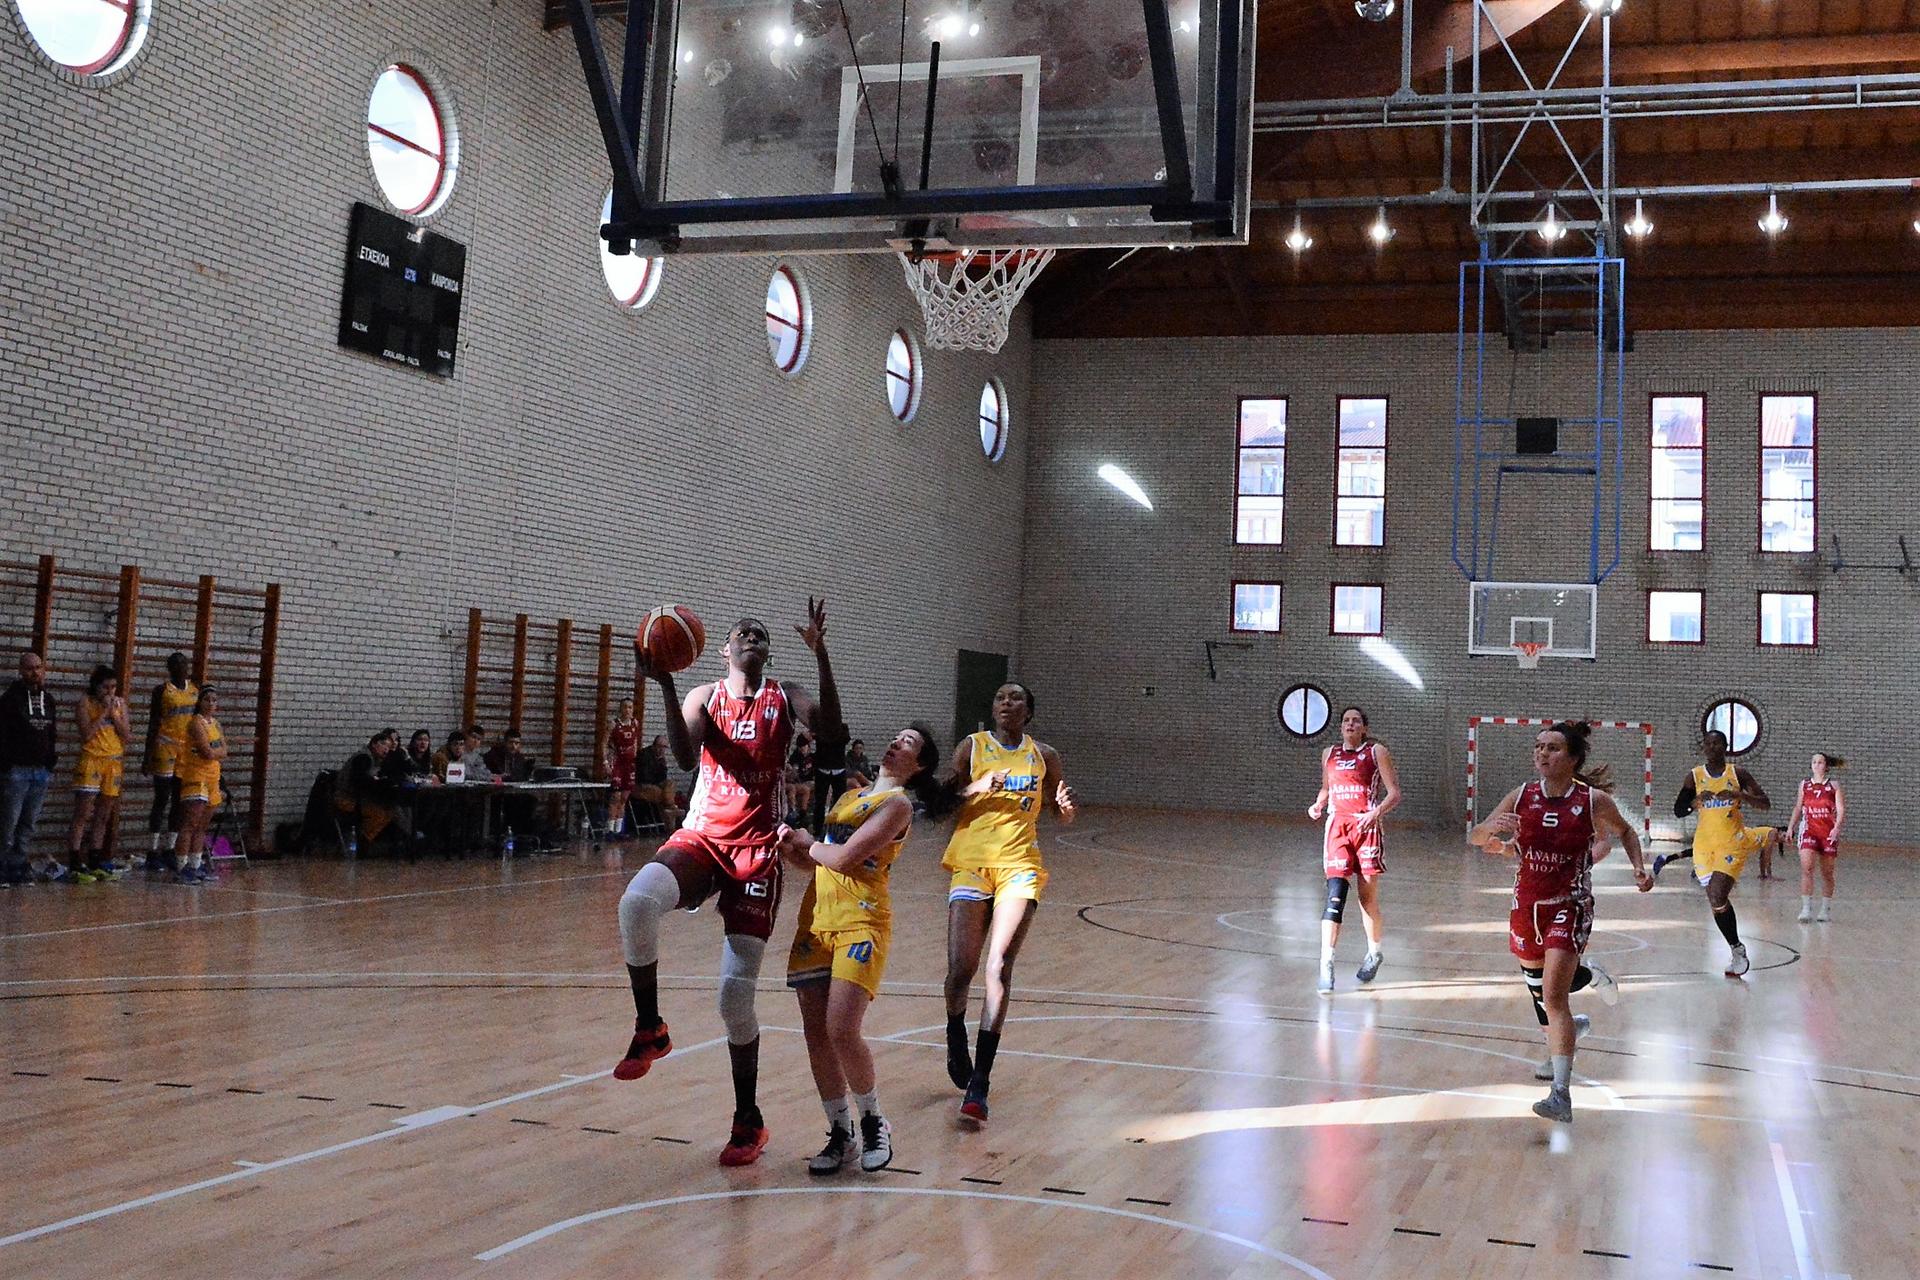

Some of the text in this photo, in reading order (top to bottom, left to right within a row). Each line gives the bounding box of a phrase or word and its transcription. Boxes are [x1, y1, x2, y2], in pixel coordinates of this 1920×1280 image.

[1336, 760, 1355, 770] 32
[1813, 789, 1822, 799] 7
[1542, 812, 1559, 827] 5
[1553, 909, 1568, 924] 5
[847, 940, 873, 963] 10
